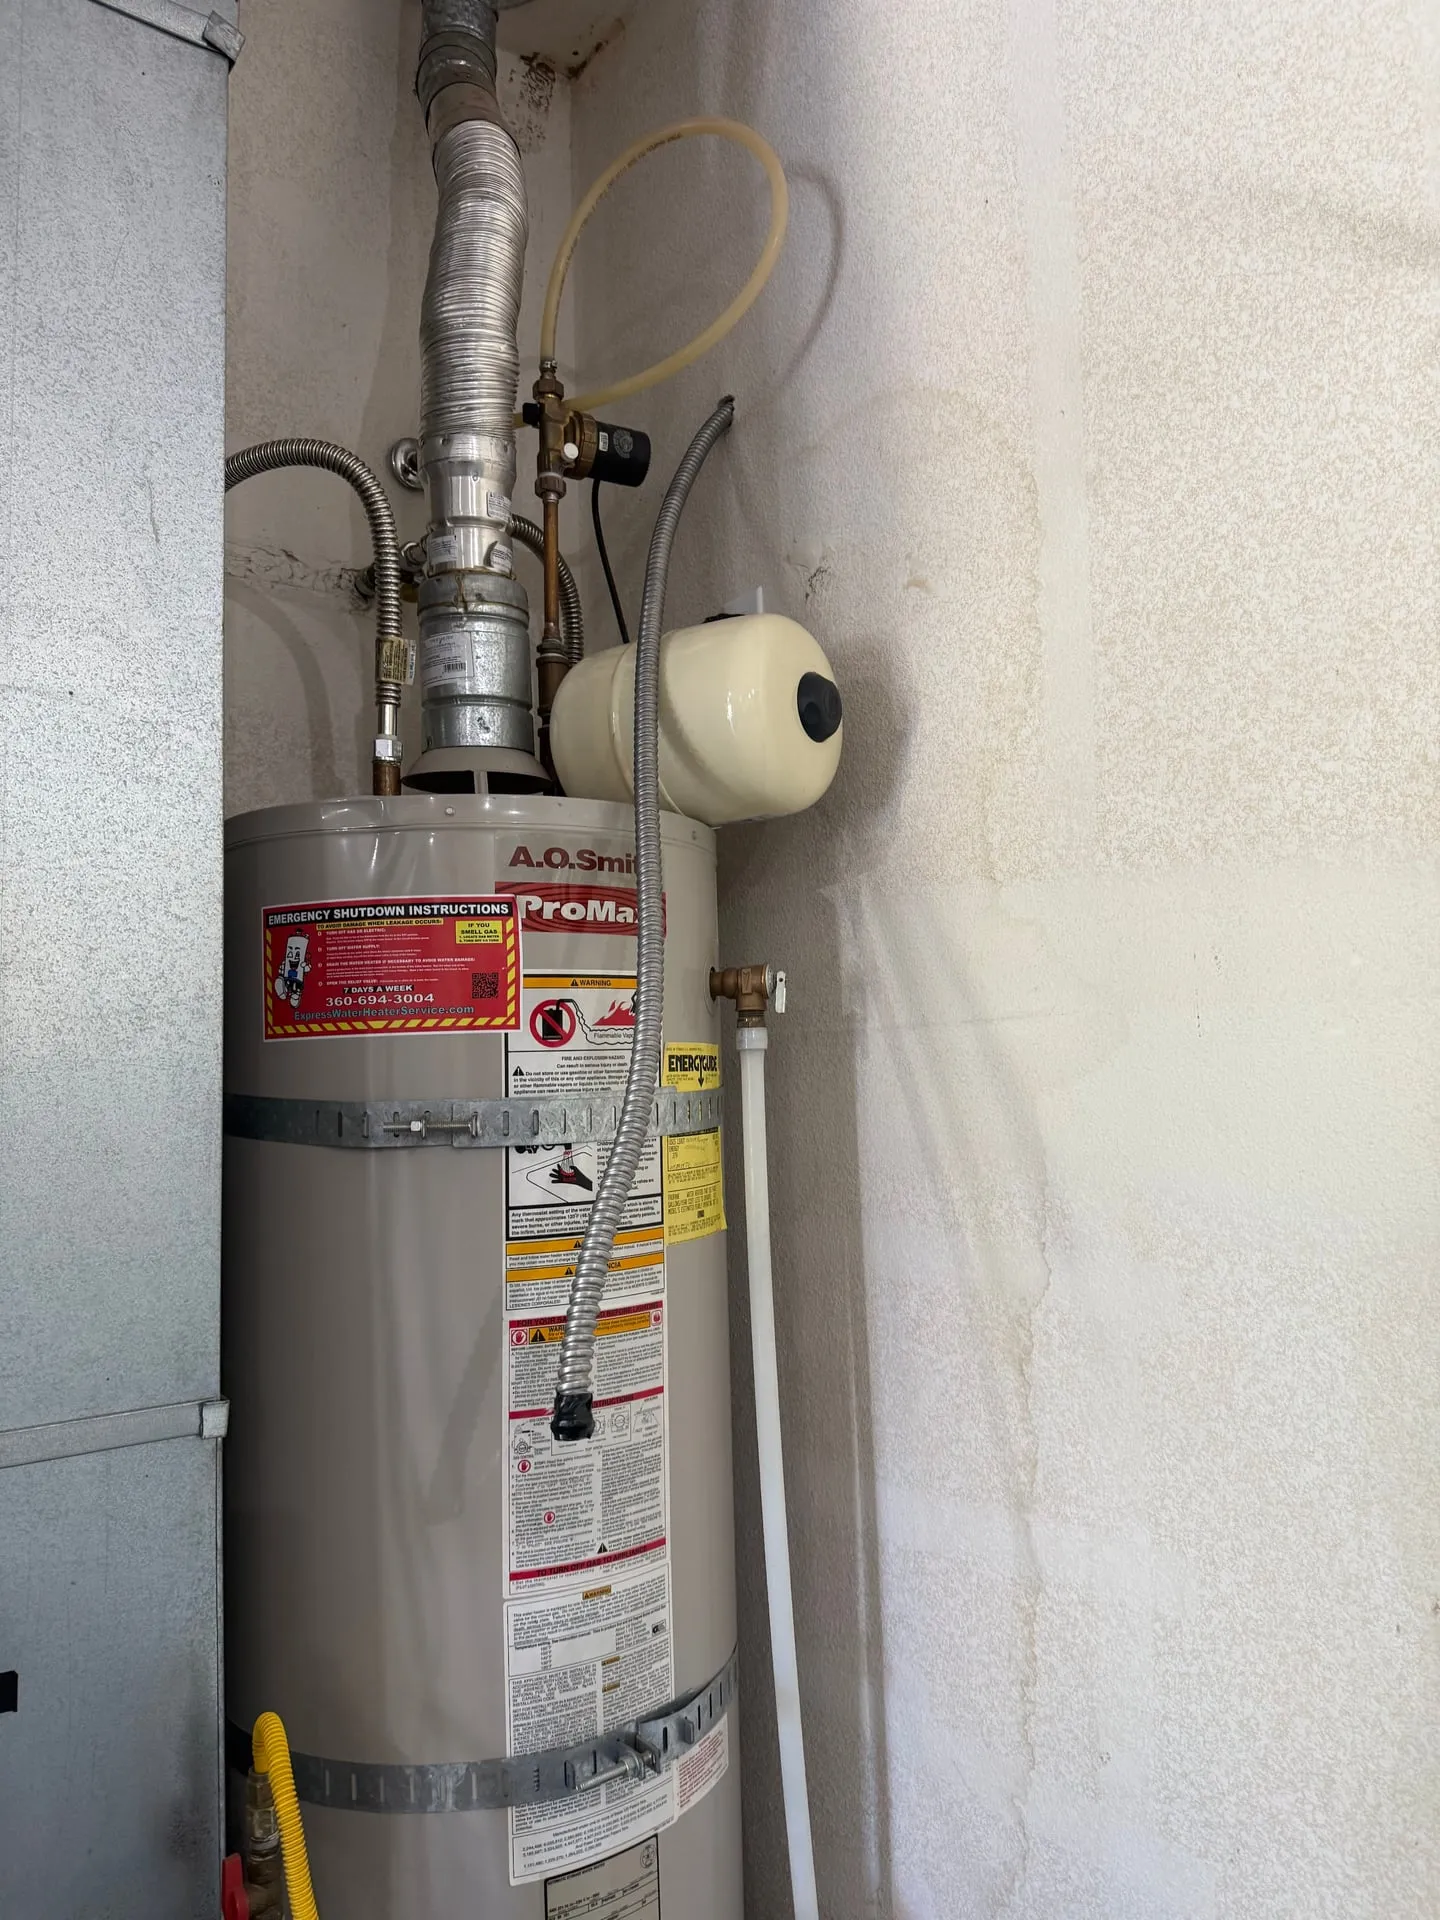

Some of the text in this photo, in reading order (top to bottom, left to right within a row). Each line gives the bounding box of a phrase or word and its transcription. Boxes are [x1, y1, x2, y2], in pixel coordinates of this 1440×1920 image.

[268, 903, 509, 926] EMERGENCY SHUTDOWN INSTRUCTIONS
[516, 895, 638, 924] ProMa
[579, 979, 612, 987] WARNING
[325, 992, 434, 1007] 360-694-3004
[294, 1005, 474, 1021] ExpressWaterHeaterService.com
